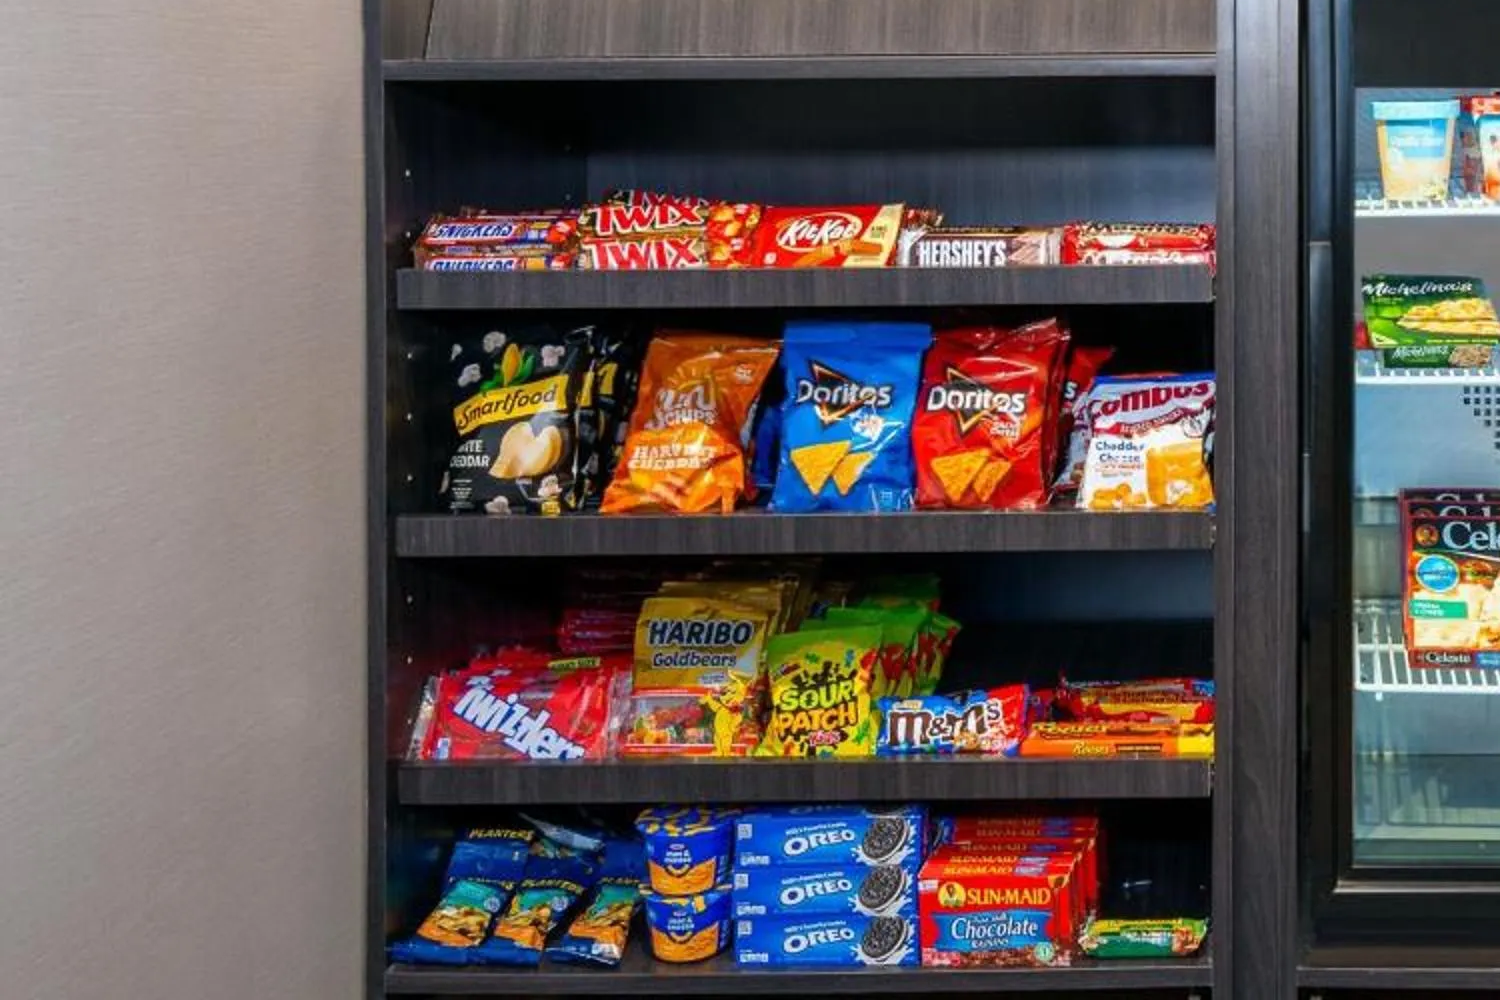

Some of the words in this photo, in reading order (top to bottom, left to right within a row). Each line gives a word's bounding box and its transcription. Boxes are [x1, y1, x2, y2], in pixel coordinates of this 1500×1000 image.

[595, 204, 705, 235] TWIX
[586, 238, 701, 268] TWIX
[459, 383, 558, 428] Smartfood
[796, 380, 893, 405] Doritos
[927, 386, 1026, 413] Doritos
[457, 440, 484, 453] ITE
[648, 619, 754, 647] HARIBO
[653, 651, 738, 668] Goldbears
[1426, 652, 1471, 665] Celeste
[781, 681, 854, 711] SOUR
[779, 701, 858, 735] PATCH
[783, 829, 856, 856] OREO
[780, 879, 853, 905] OREO
[783, 927, 855, 953] OREO
[951, 917, 1039, 940] Chocolate
